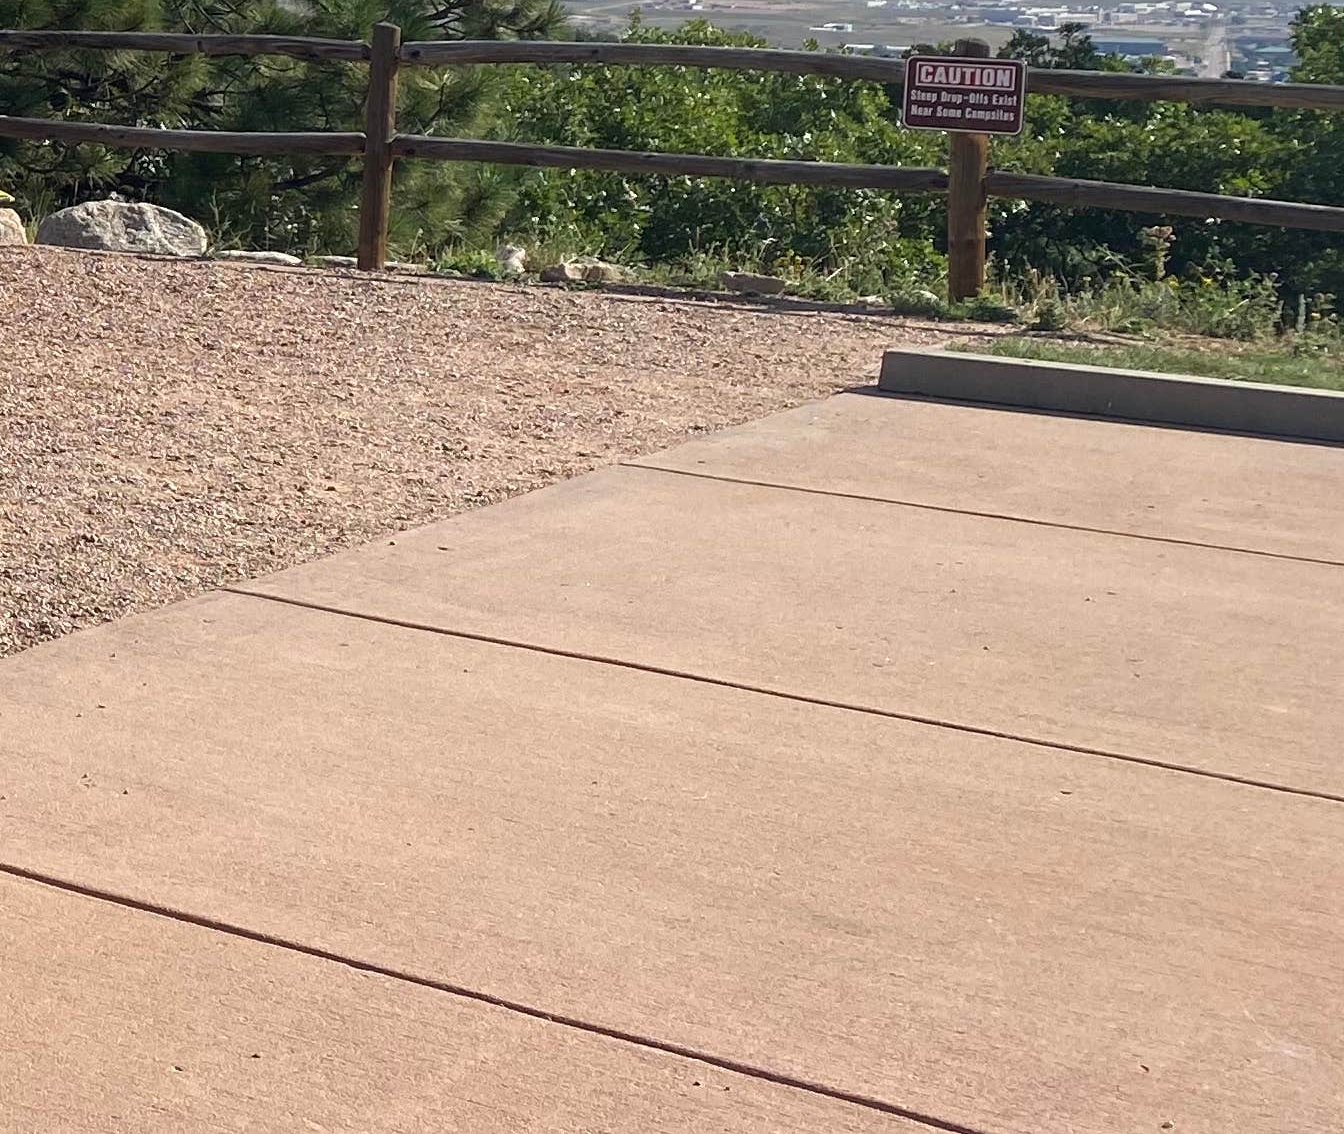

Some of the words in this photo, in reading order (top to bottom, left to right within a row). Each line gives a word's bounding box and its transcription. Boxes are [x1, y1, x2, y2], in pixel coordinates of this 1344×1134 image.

[920, 65, 1011, 87] CAUTION
[910, 89, 938, 103] Steep
[941, 91, 989, 105] Drop-Offs
[993, 94, 1017, 106] Exist
[911, 104, 934, 116] Near
[936, 106, 962, 118] Some
[965, 108, 1015, 122] Campsites
